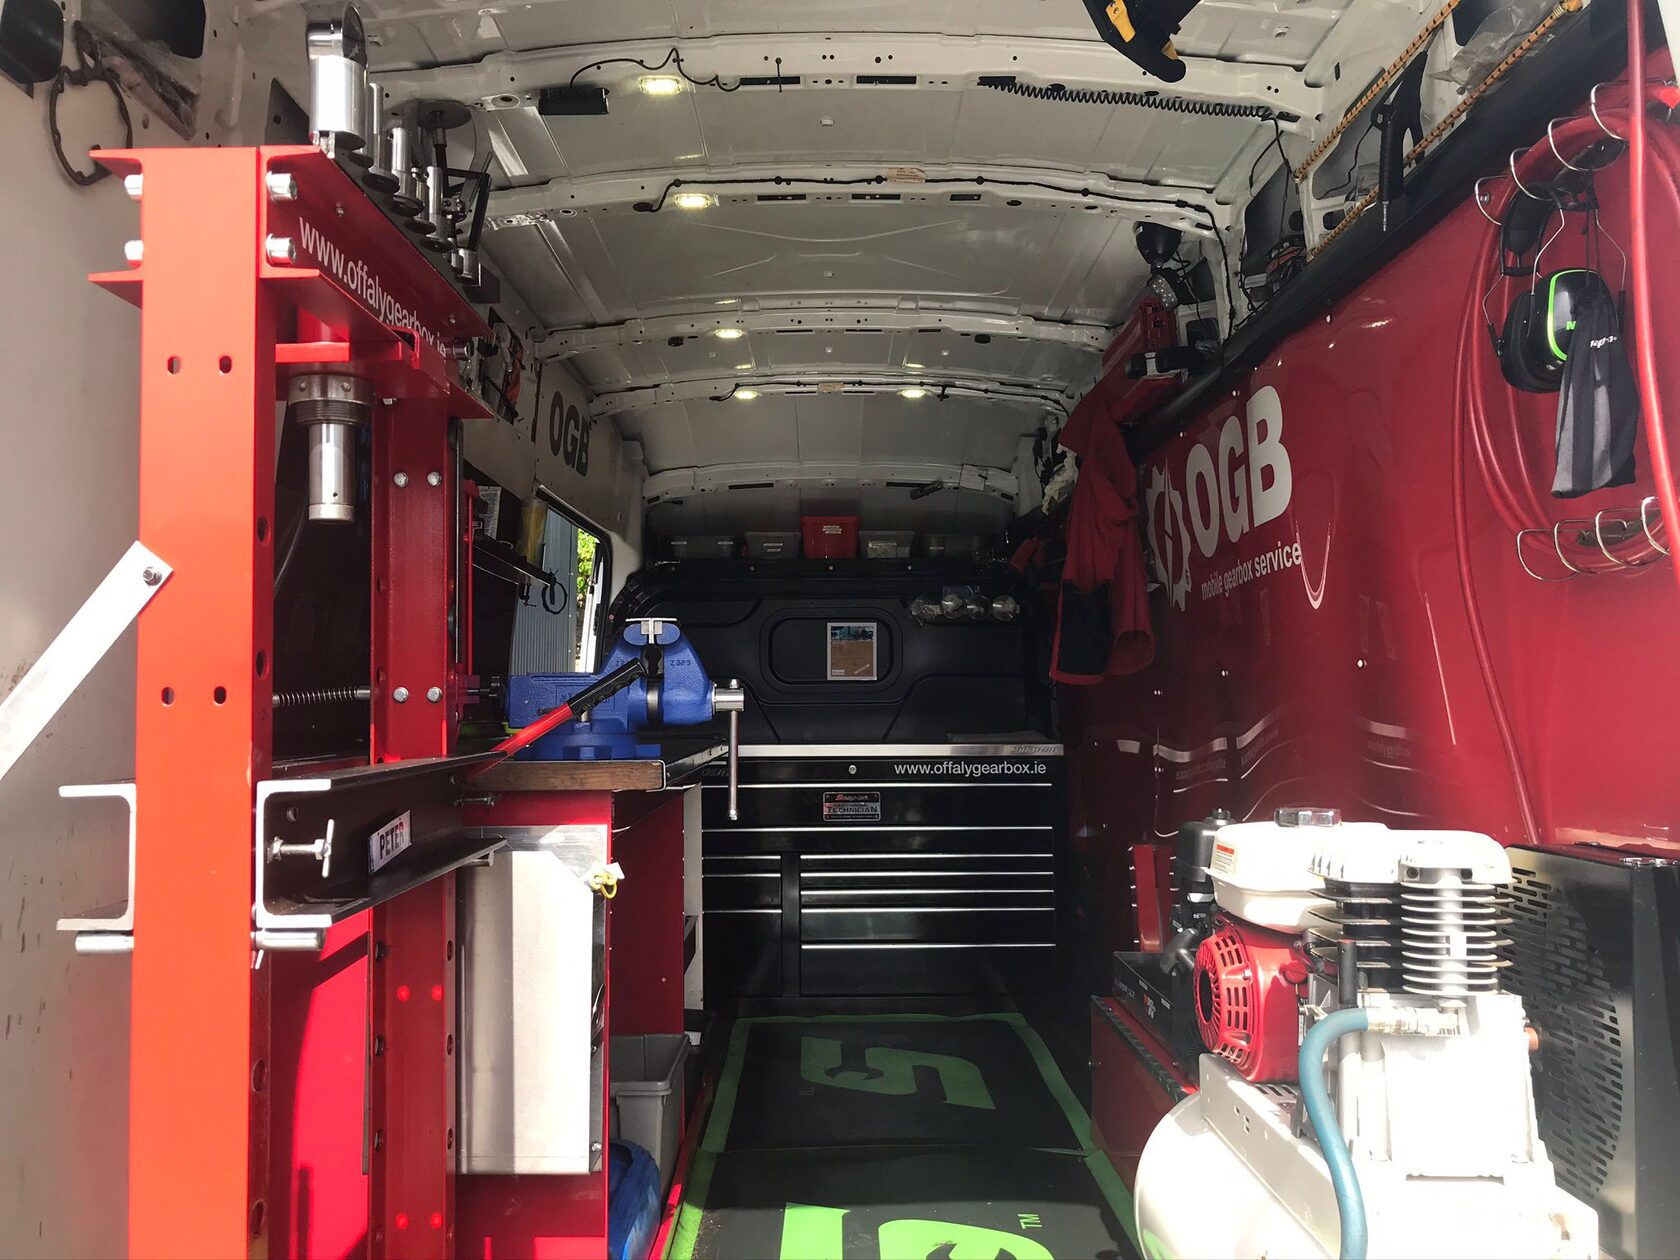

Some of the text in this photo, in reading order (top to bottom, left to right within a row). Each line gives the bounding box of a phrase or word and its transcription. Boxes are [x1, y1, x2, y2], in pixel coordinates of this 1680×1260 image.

[549, 390, 590, 477] OGB
[1186, 386, 1293, 558] OGB
[1201, 540, 1303, 601] mobile gearbox service
[894, 760, 1047, 778] www.offalygearbox.ie
[379, 821, 404, 860] PETER
